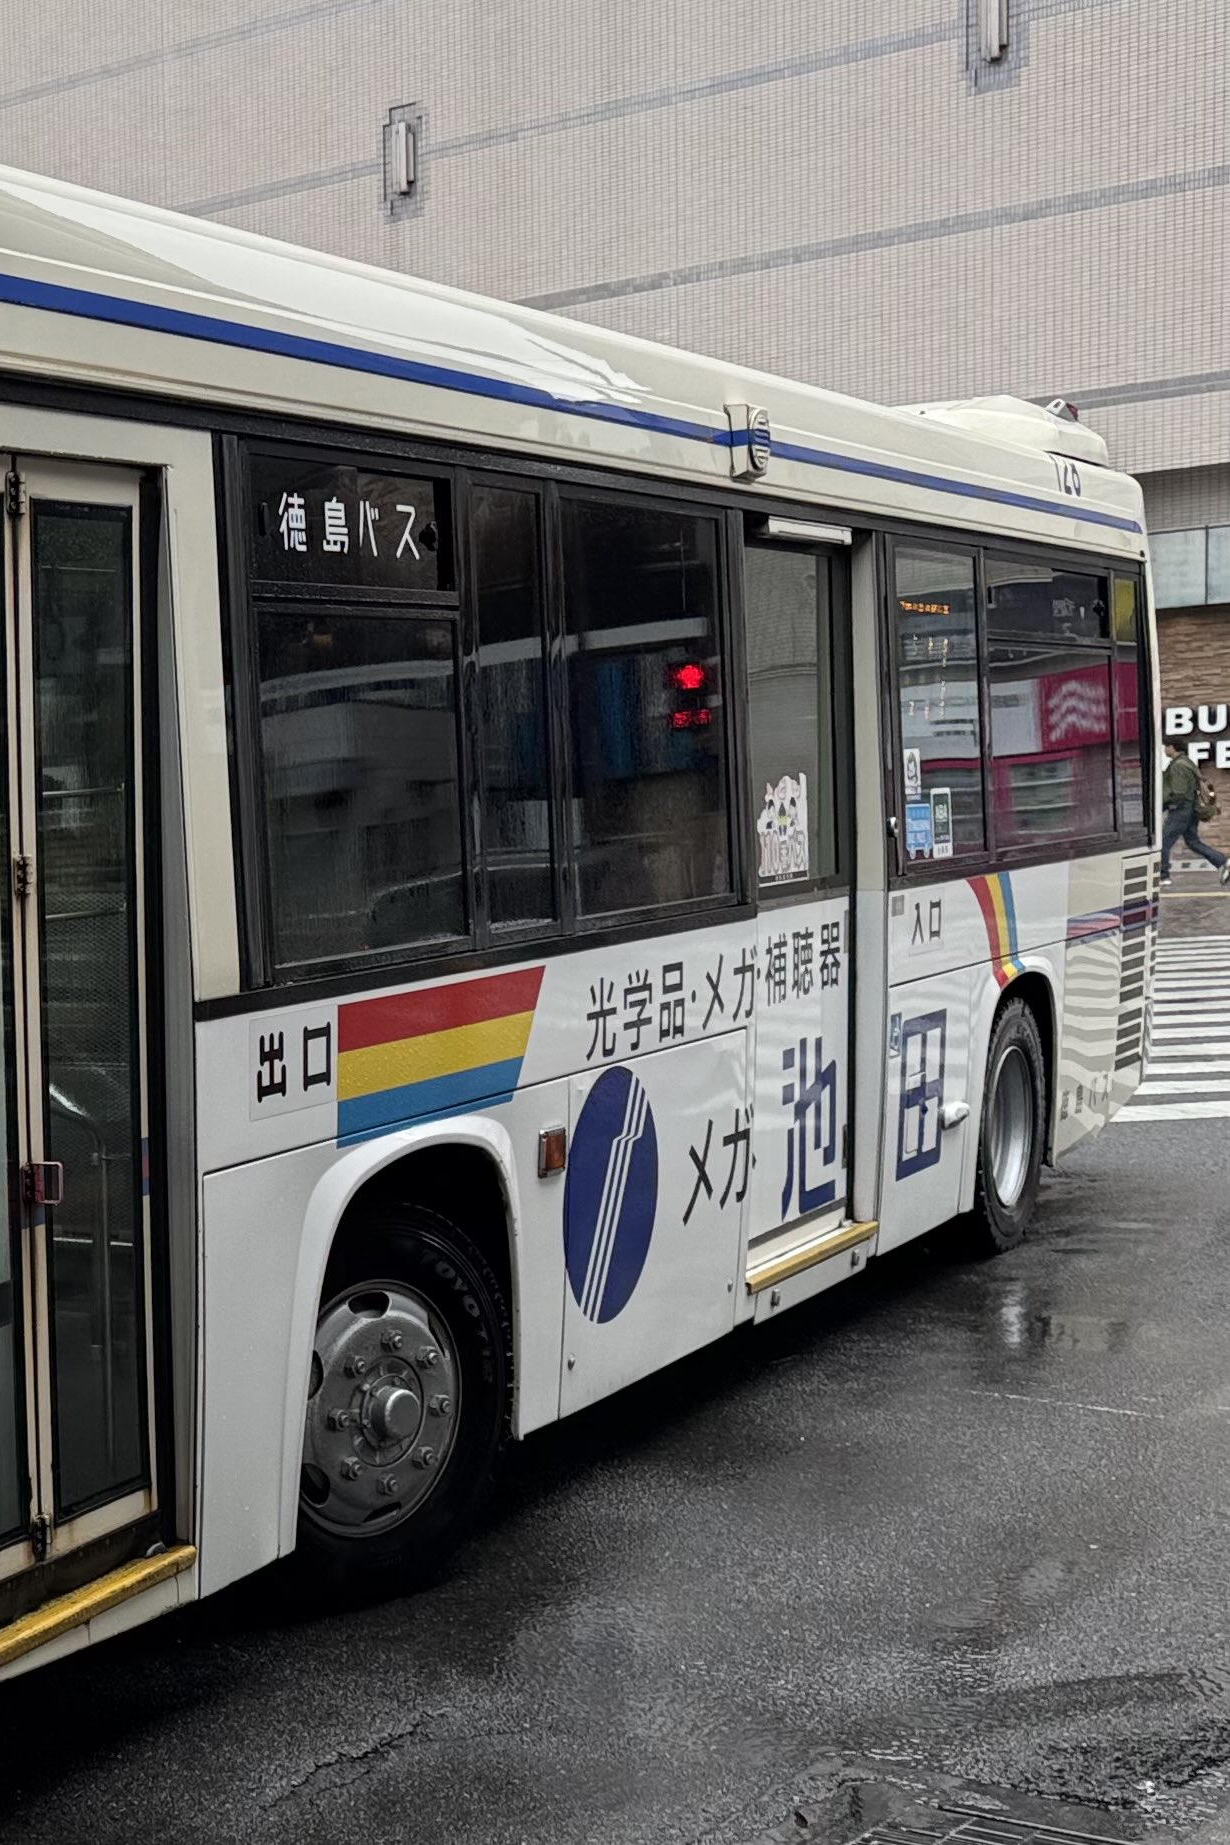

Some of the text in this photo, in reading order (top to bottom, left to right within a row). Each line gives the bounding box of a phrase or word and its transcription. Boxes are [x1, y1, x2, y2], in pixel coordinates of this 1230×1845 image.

[278, 491, 420, 560] 徳島バス
[1166, 704, 1227, 735] BU
[1162, 740, 1230, 772] FE
[912, 899, 941, 945] 入口
[257, 1021, 332, 1103] 出口
[682, 1103, 757, 1227] メガ
